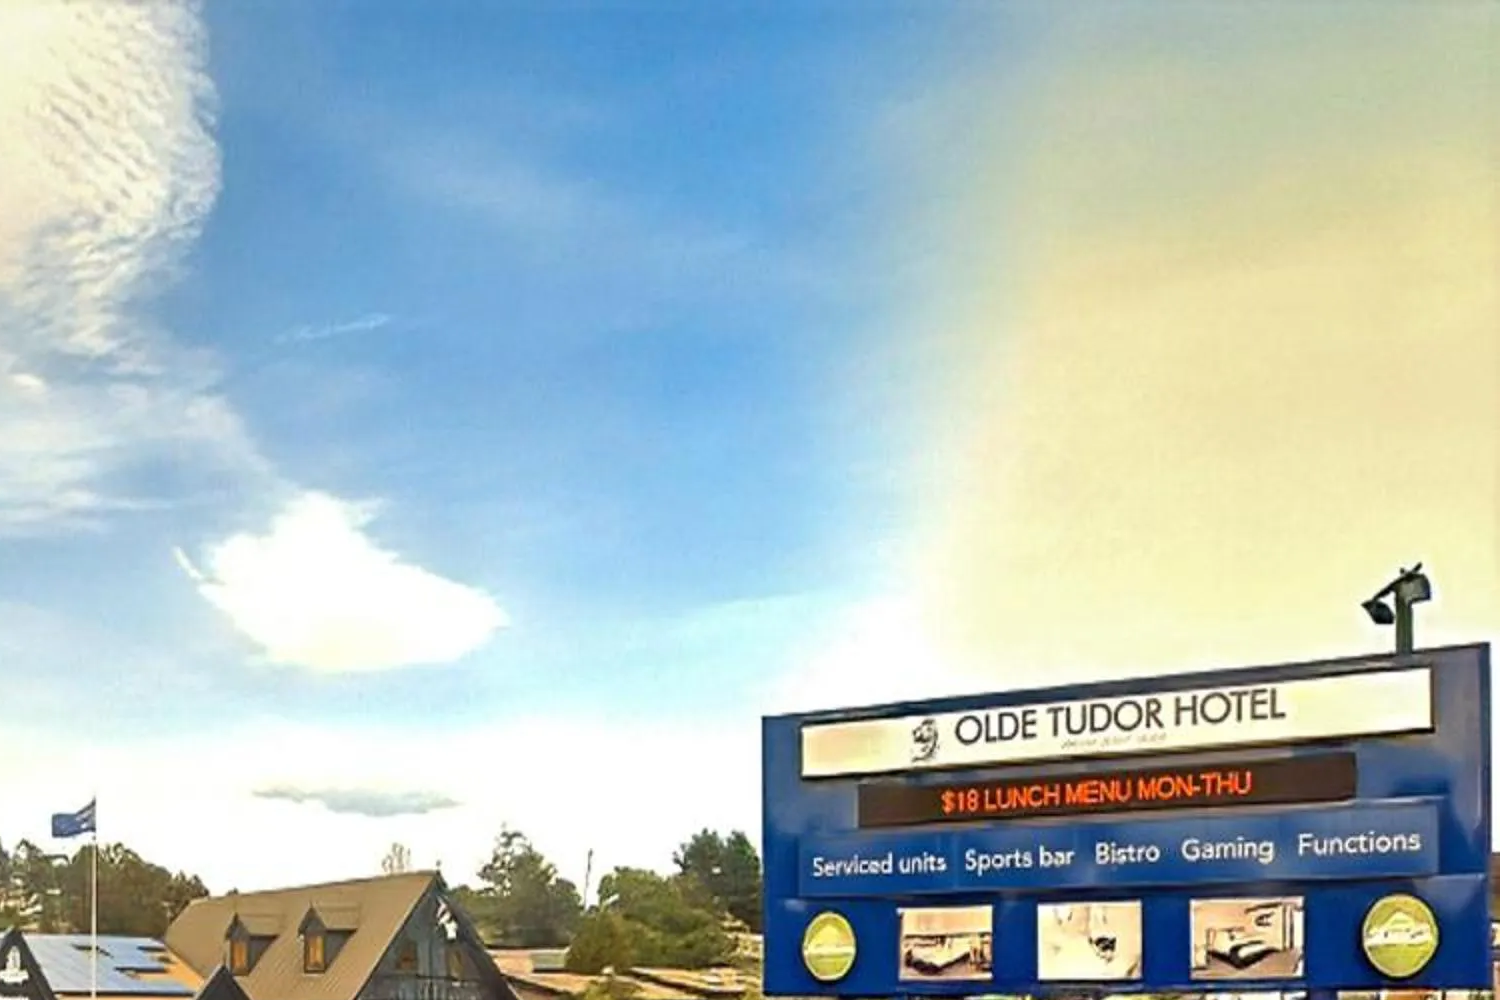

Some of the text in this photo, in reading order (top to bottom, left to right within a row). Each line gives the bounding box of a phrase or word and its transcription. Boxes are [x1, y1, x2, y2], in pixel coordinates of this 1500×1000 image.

[955, 687, 1286, 746] OLDE TUDOR HOTEL
[941, 770, 1252, 814] $18 LUNCH MENU MON-THU
[812, 830, 1421, 877] Serviced units Sports bar Bistro Gaming Functions
